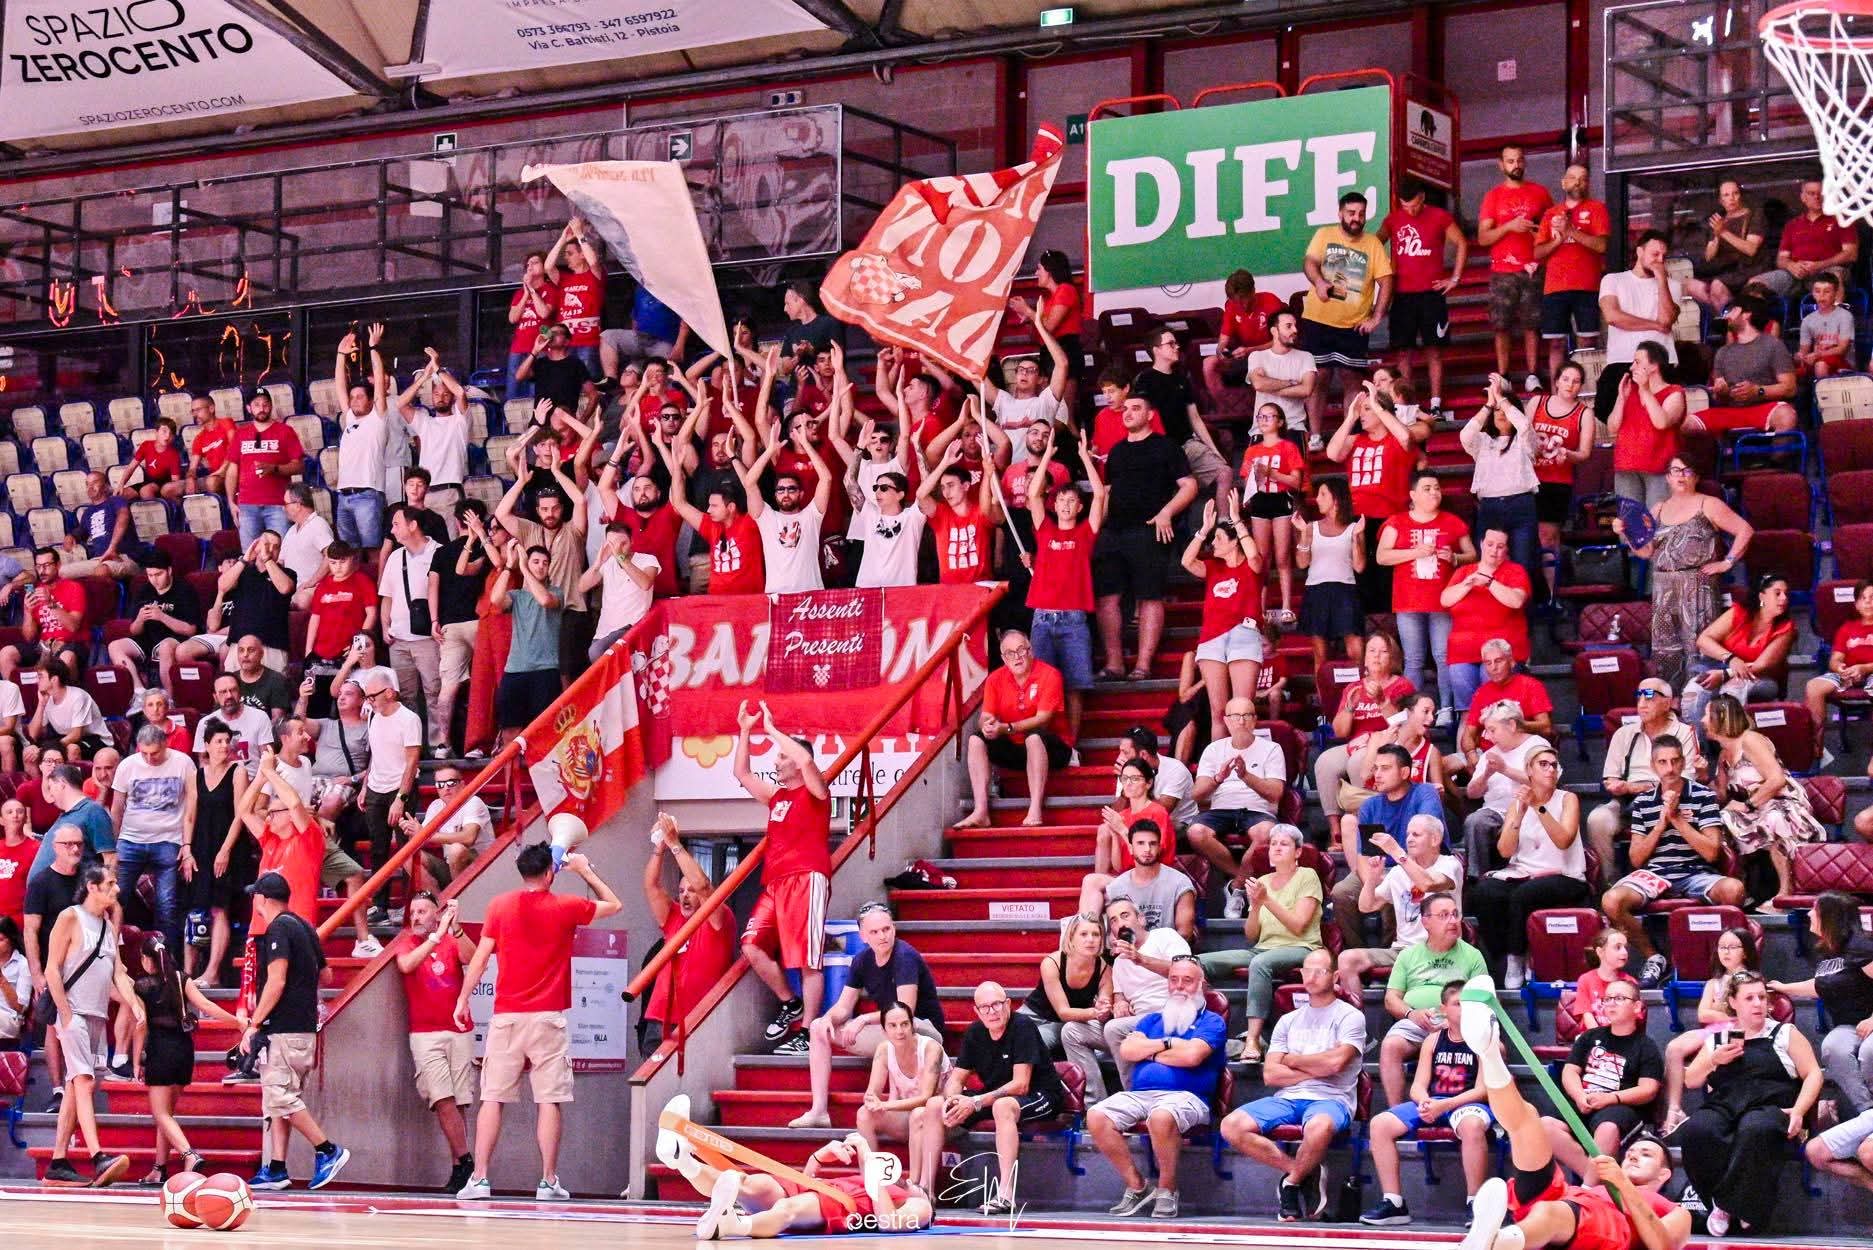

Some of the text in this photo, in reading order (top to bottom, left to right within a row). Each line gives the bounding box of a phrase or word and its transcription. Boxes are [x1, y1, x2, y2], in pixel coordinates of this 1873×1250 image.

[25, 0, 187, 46] SPAZIO
[517, 27, 546, 38] 0573
[600, 18, 621, 29] 347
[624, 8, 678, 26] 6597922
[528, 40, 549, 50] Via
[551, 39, 564, 48] C.
[616, 31, 629, 41] 12
[637, 23, 681, 38] Pistoia
[10, 22, 254, 83] ZEROCENTO
[79, 95, 246, 126] SPAZIOZEROCENTO.COM
[1105, 131, 1378, 248] DIFE
[788, 596, 865, 623] Assenti
[784, 630, 865, 659] Presenti
[1002, 904, 1035, 912] VIETATO
[472, 982, 494, 996] stra
[1455, 1053, 1473, 1065] TEAM
